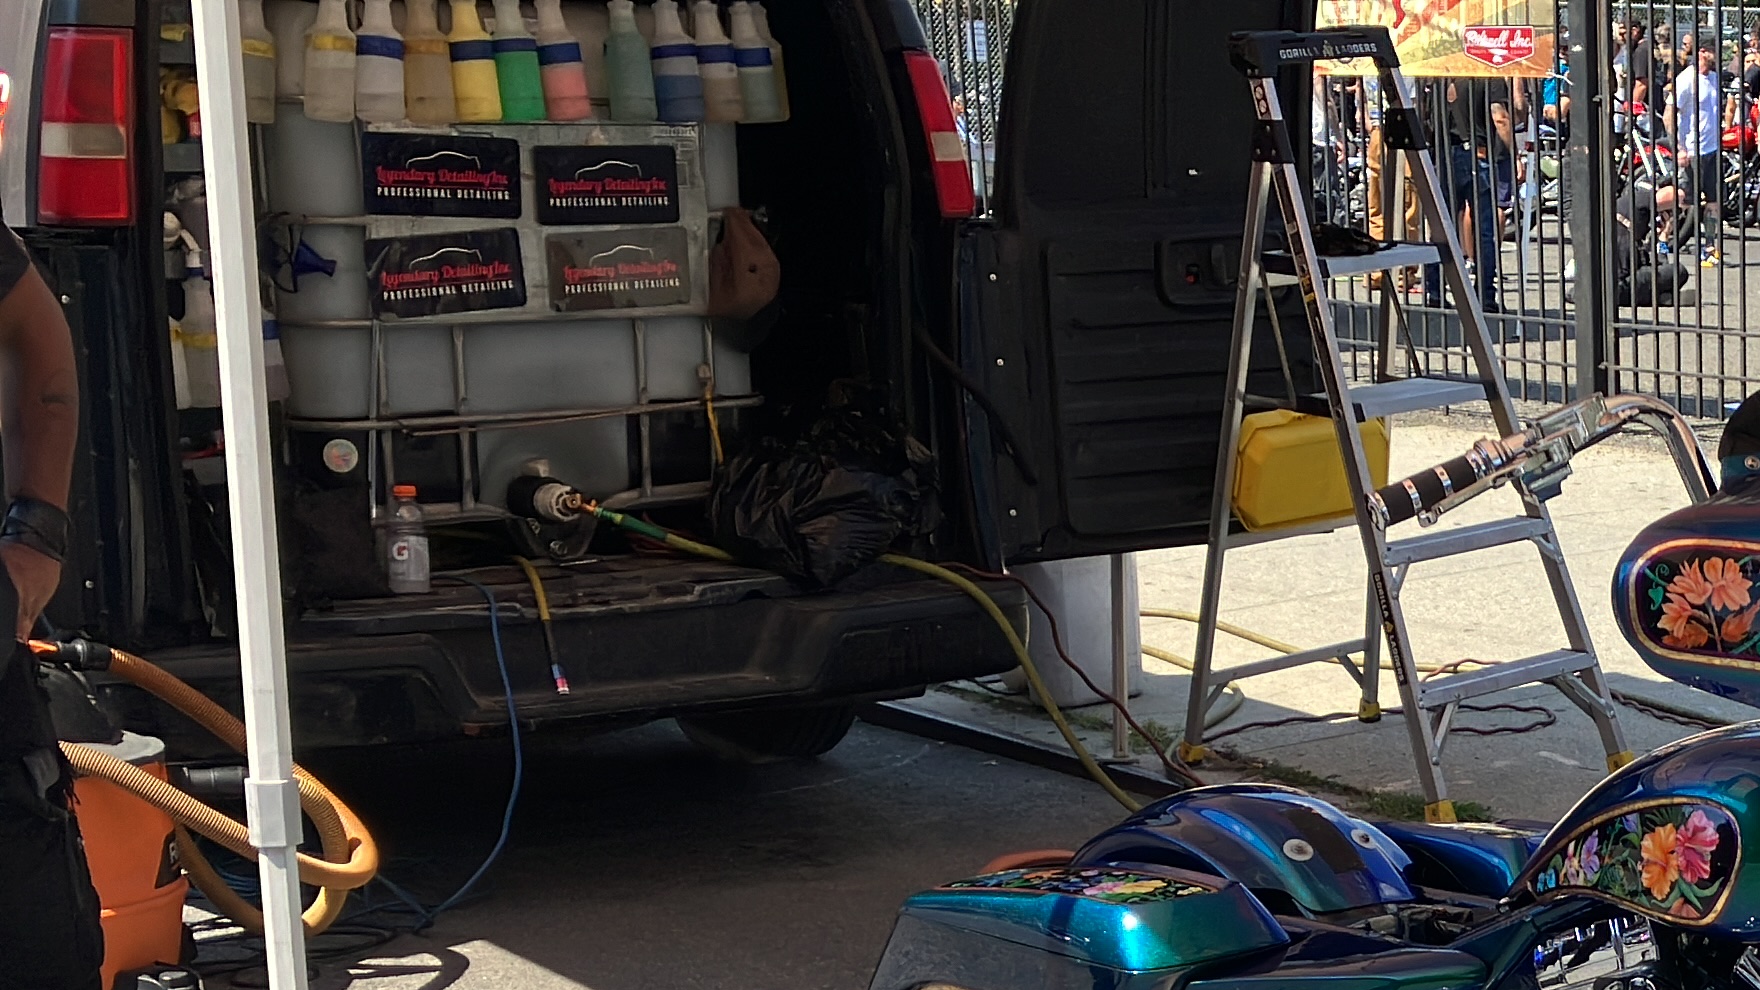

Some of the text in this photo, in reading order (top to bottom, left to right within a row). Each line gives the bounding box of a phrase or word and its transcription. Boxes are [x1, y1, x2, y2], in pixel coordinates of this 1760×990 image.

[1279, 43, 1377, 59] GORILLA LADDERS
[377, 186, 510, 200] PROFESSIONAL DETAILING
[550, 196, 669, 207] PROFESSIONAL DETAILING
[383, 279, 514, 300] PROFESSIONAL DETAILING
[565, 277, 680, 295] PROFESSIONAL DETAILING
[1374, 574, 1405, 681] GORILLA LADDERS
